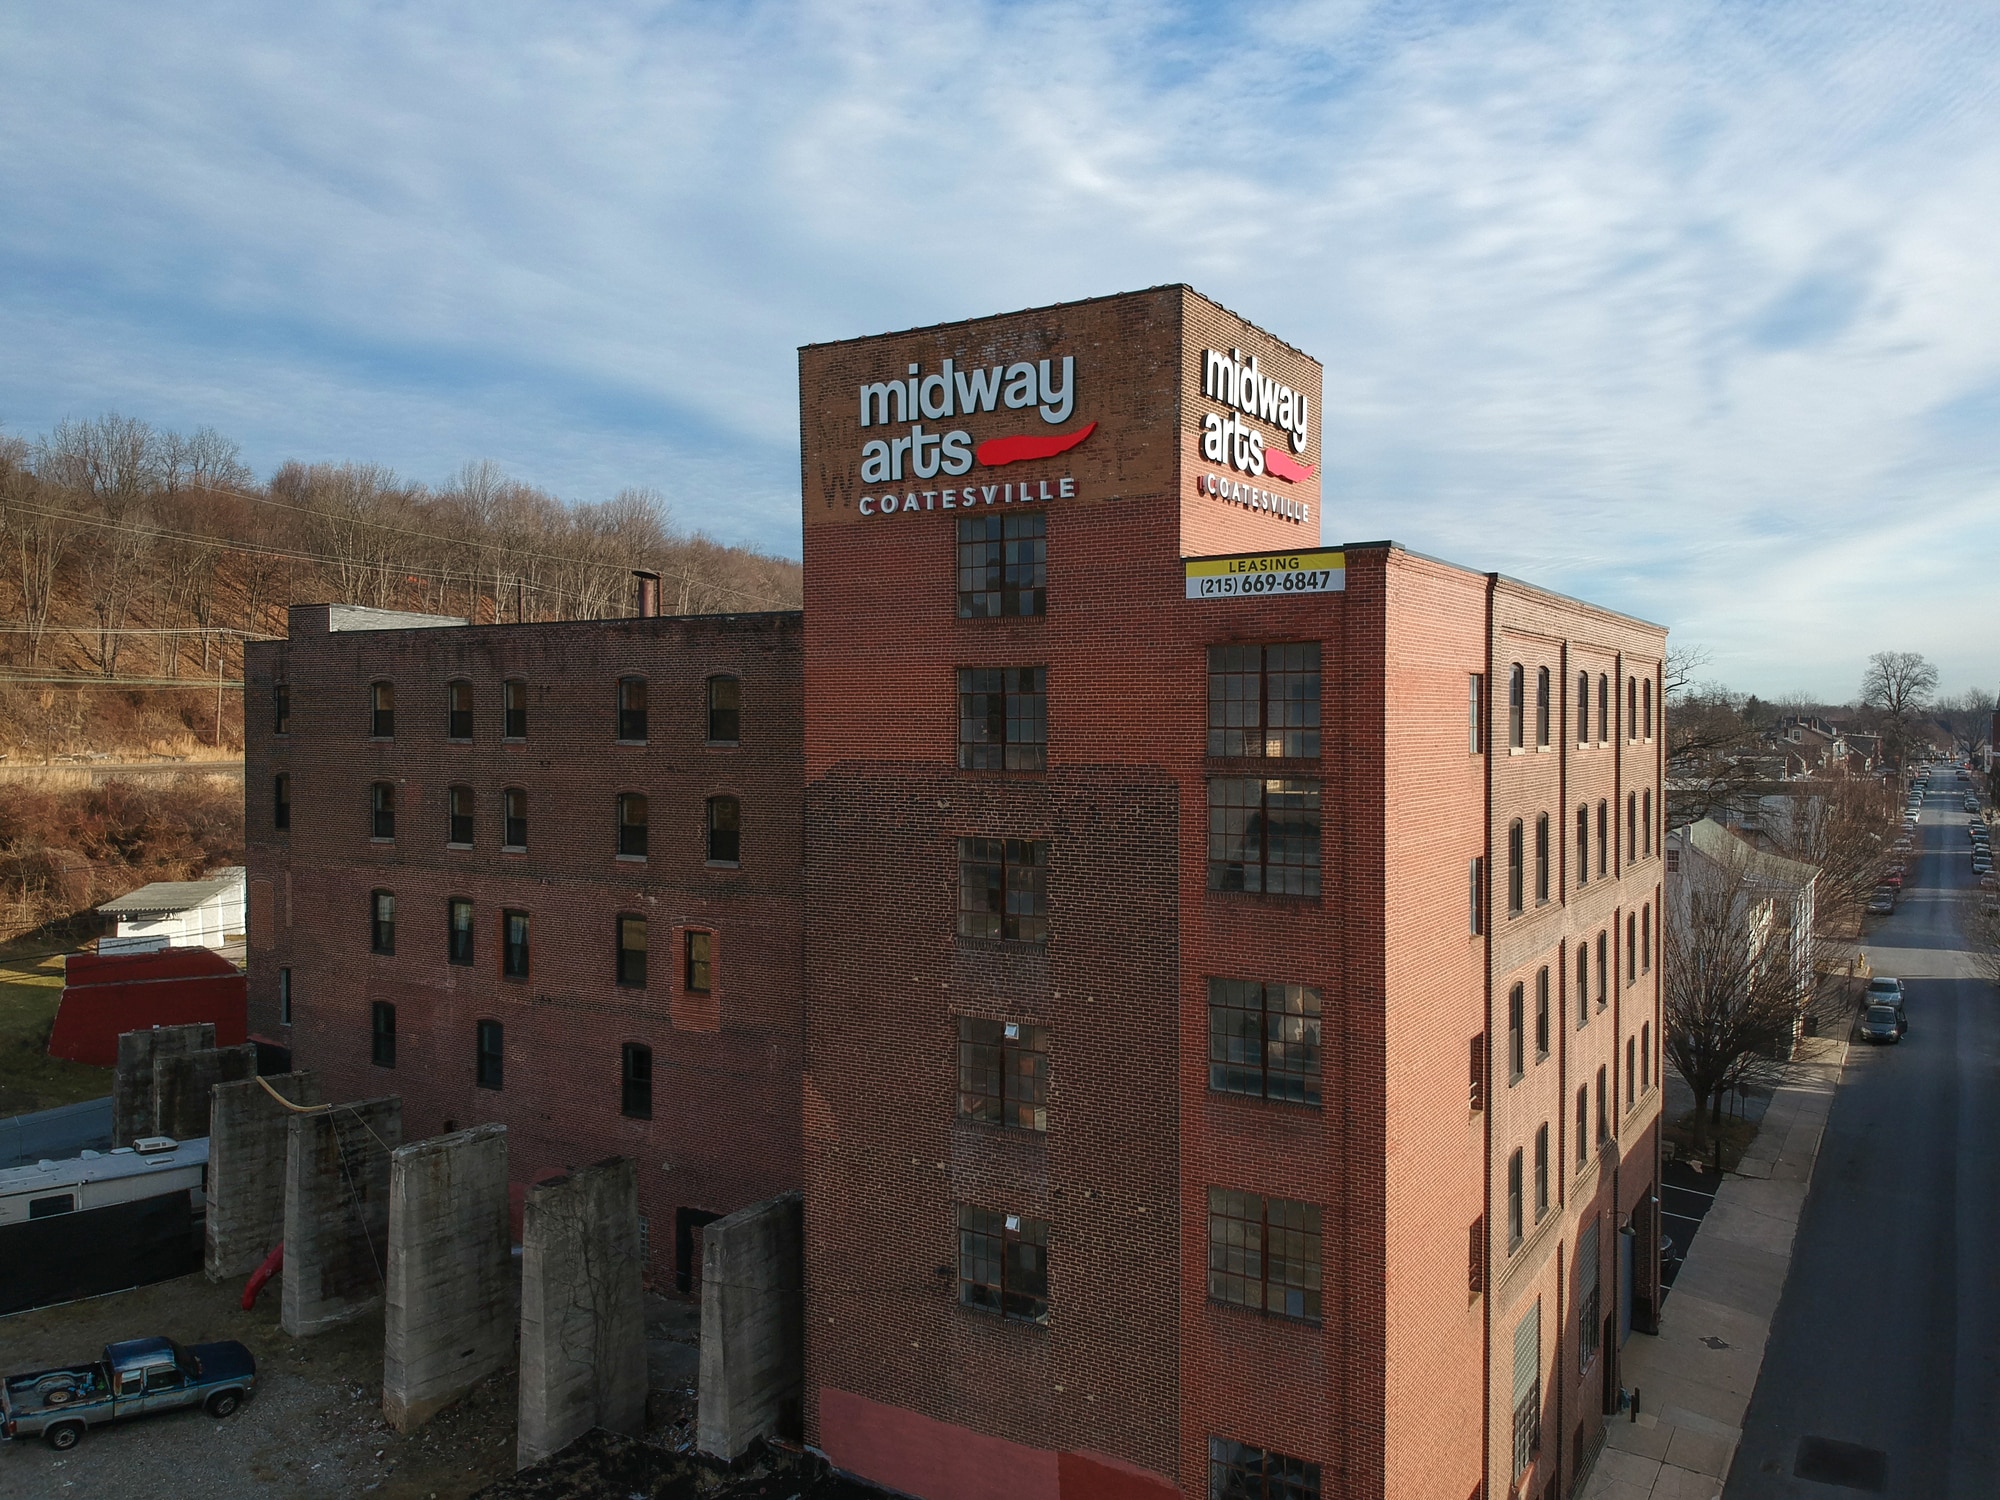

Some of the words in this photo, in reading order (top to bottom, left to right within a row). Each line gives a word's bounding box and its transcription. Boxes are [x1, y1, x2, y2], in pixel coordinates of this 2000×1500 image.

[859, 356, 1075, 427] midway
[1203, 348, 1308, 454] midway
[860, 424, 974, 484] arts
[1203, 410, 1265, 477] arts
[858, 477, 1077, 516] COATESVILLE
[1205, 473, 1309, 523] COATESVILLE
[1200, 576, 1238, 596] (215)
[1241, 570, 1330, 593] 669-6847
[1229, 557, 1300, 573] LEASING
